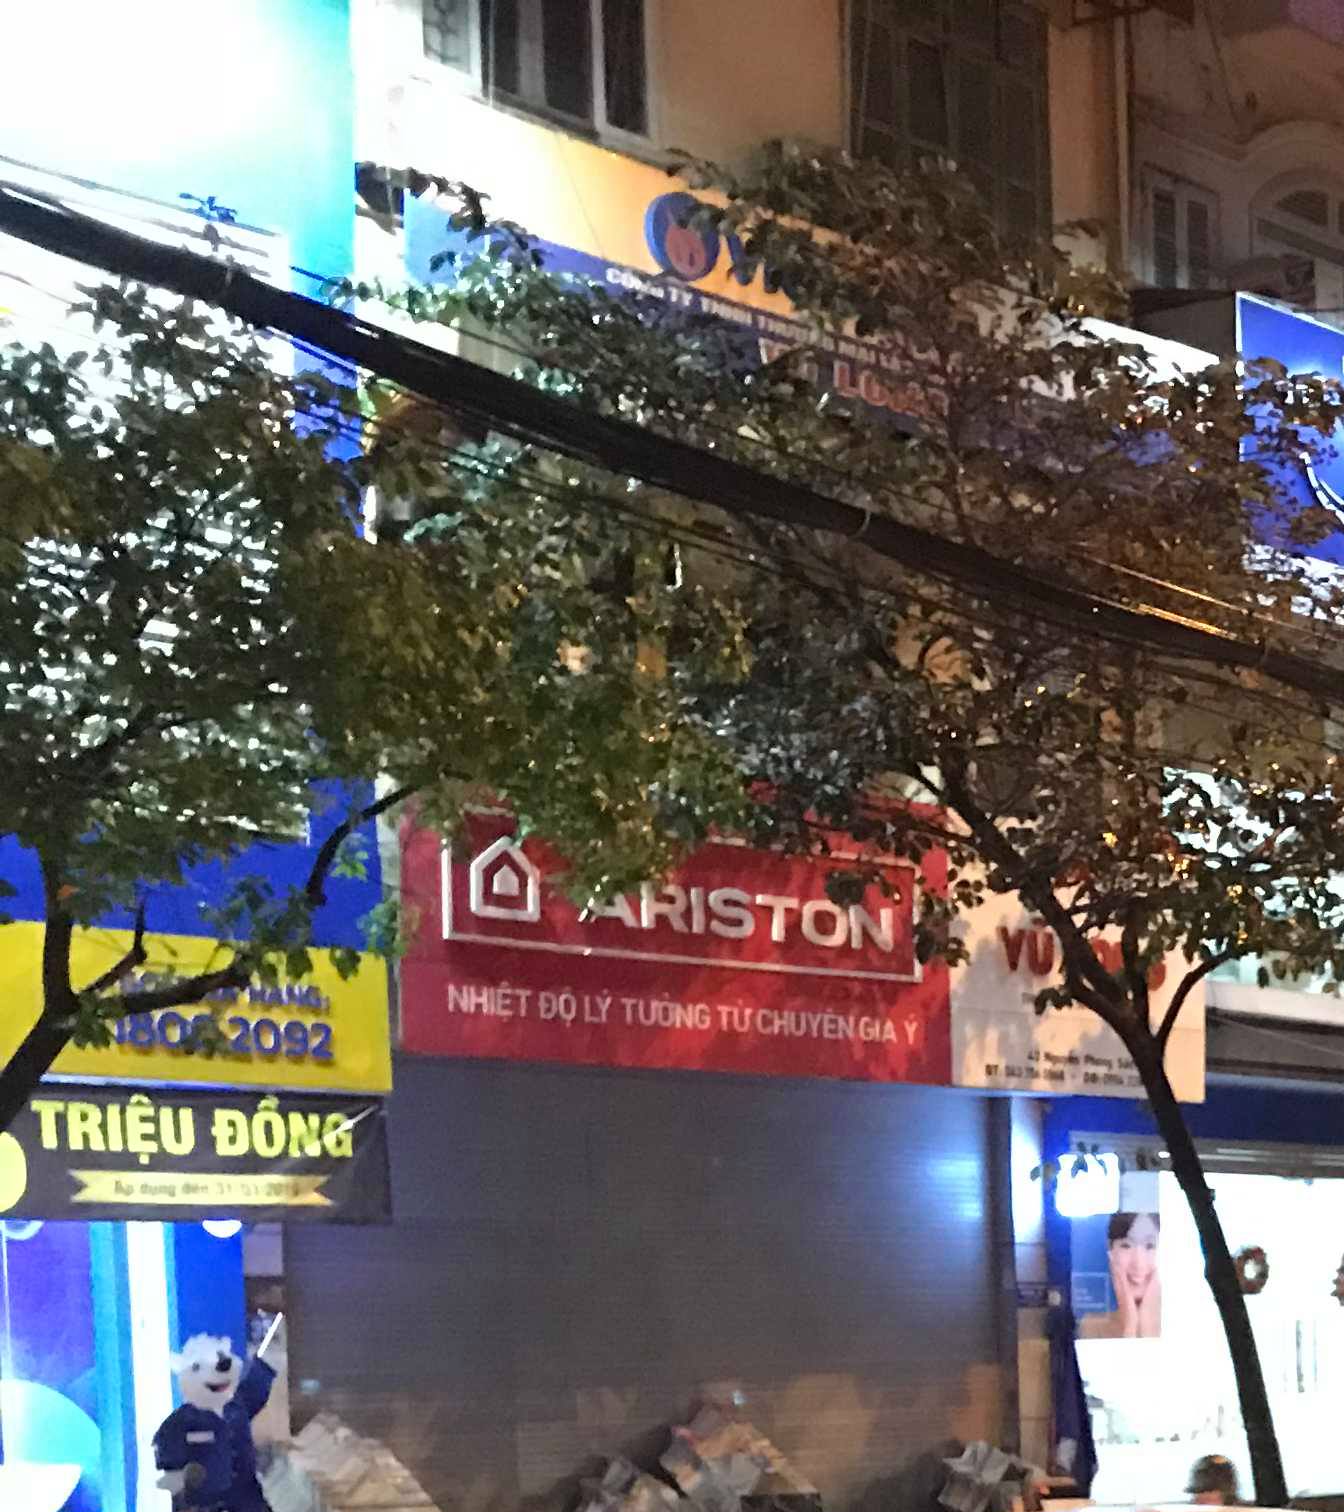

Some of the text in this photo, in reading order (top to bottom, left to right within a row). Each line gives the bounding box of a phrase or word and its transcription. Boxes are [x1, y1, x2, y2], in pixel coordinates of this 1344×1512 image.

[590, 882, 895, 953] ARISTON
[448, 981, 532, 1028] NHIỆT
[538, 987, 577, 1029] ĐỘ
[584, 987, 612, 1024] LÝ
[859, 1020, 897, 1044] GIA
[31, 1093, 353, 1165] TRIỆU ĐỒNG
